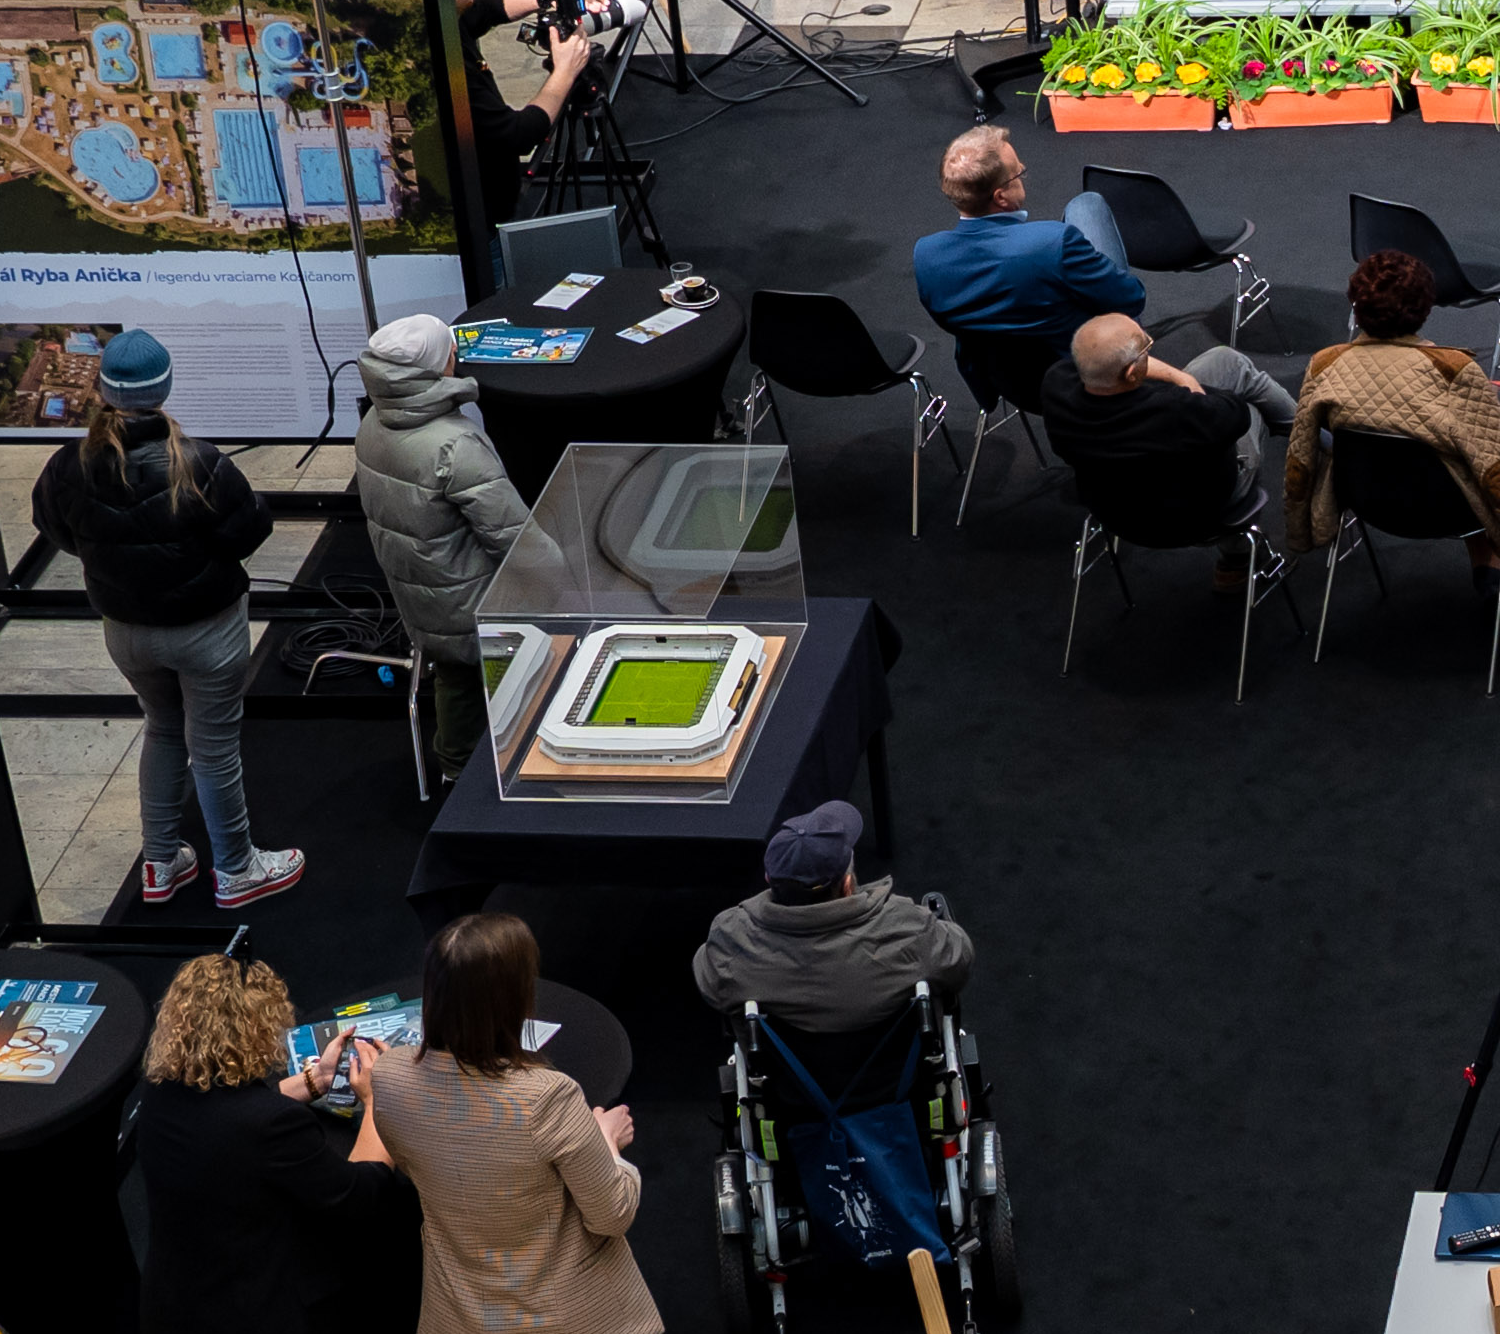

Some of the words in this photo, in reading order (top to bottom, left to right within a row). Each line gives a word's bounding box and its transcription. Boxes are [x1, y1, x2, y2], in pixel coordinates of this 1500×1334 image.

[21, 268, 70, 286] Ryba
[75, 267, 142, 283] Anička
[154, 270, 211, 287] legendu
[213, 270, 277, 283] vraciame
